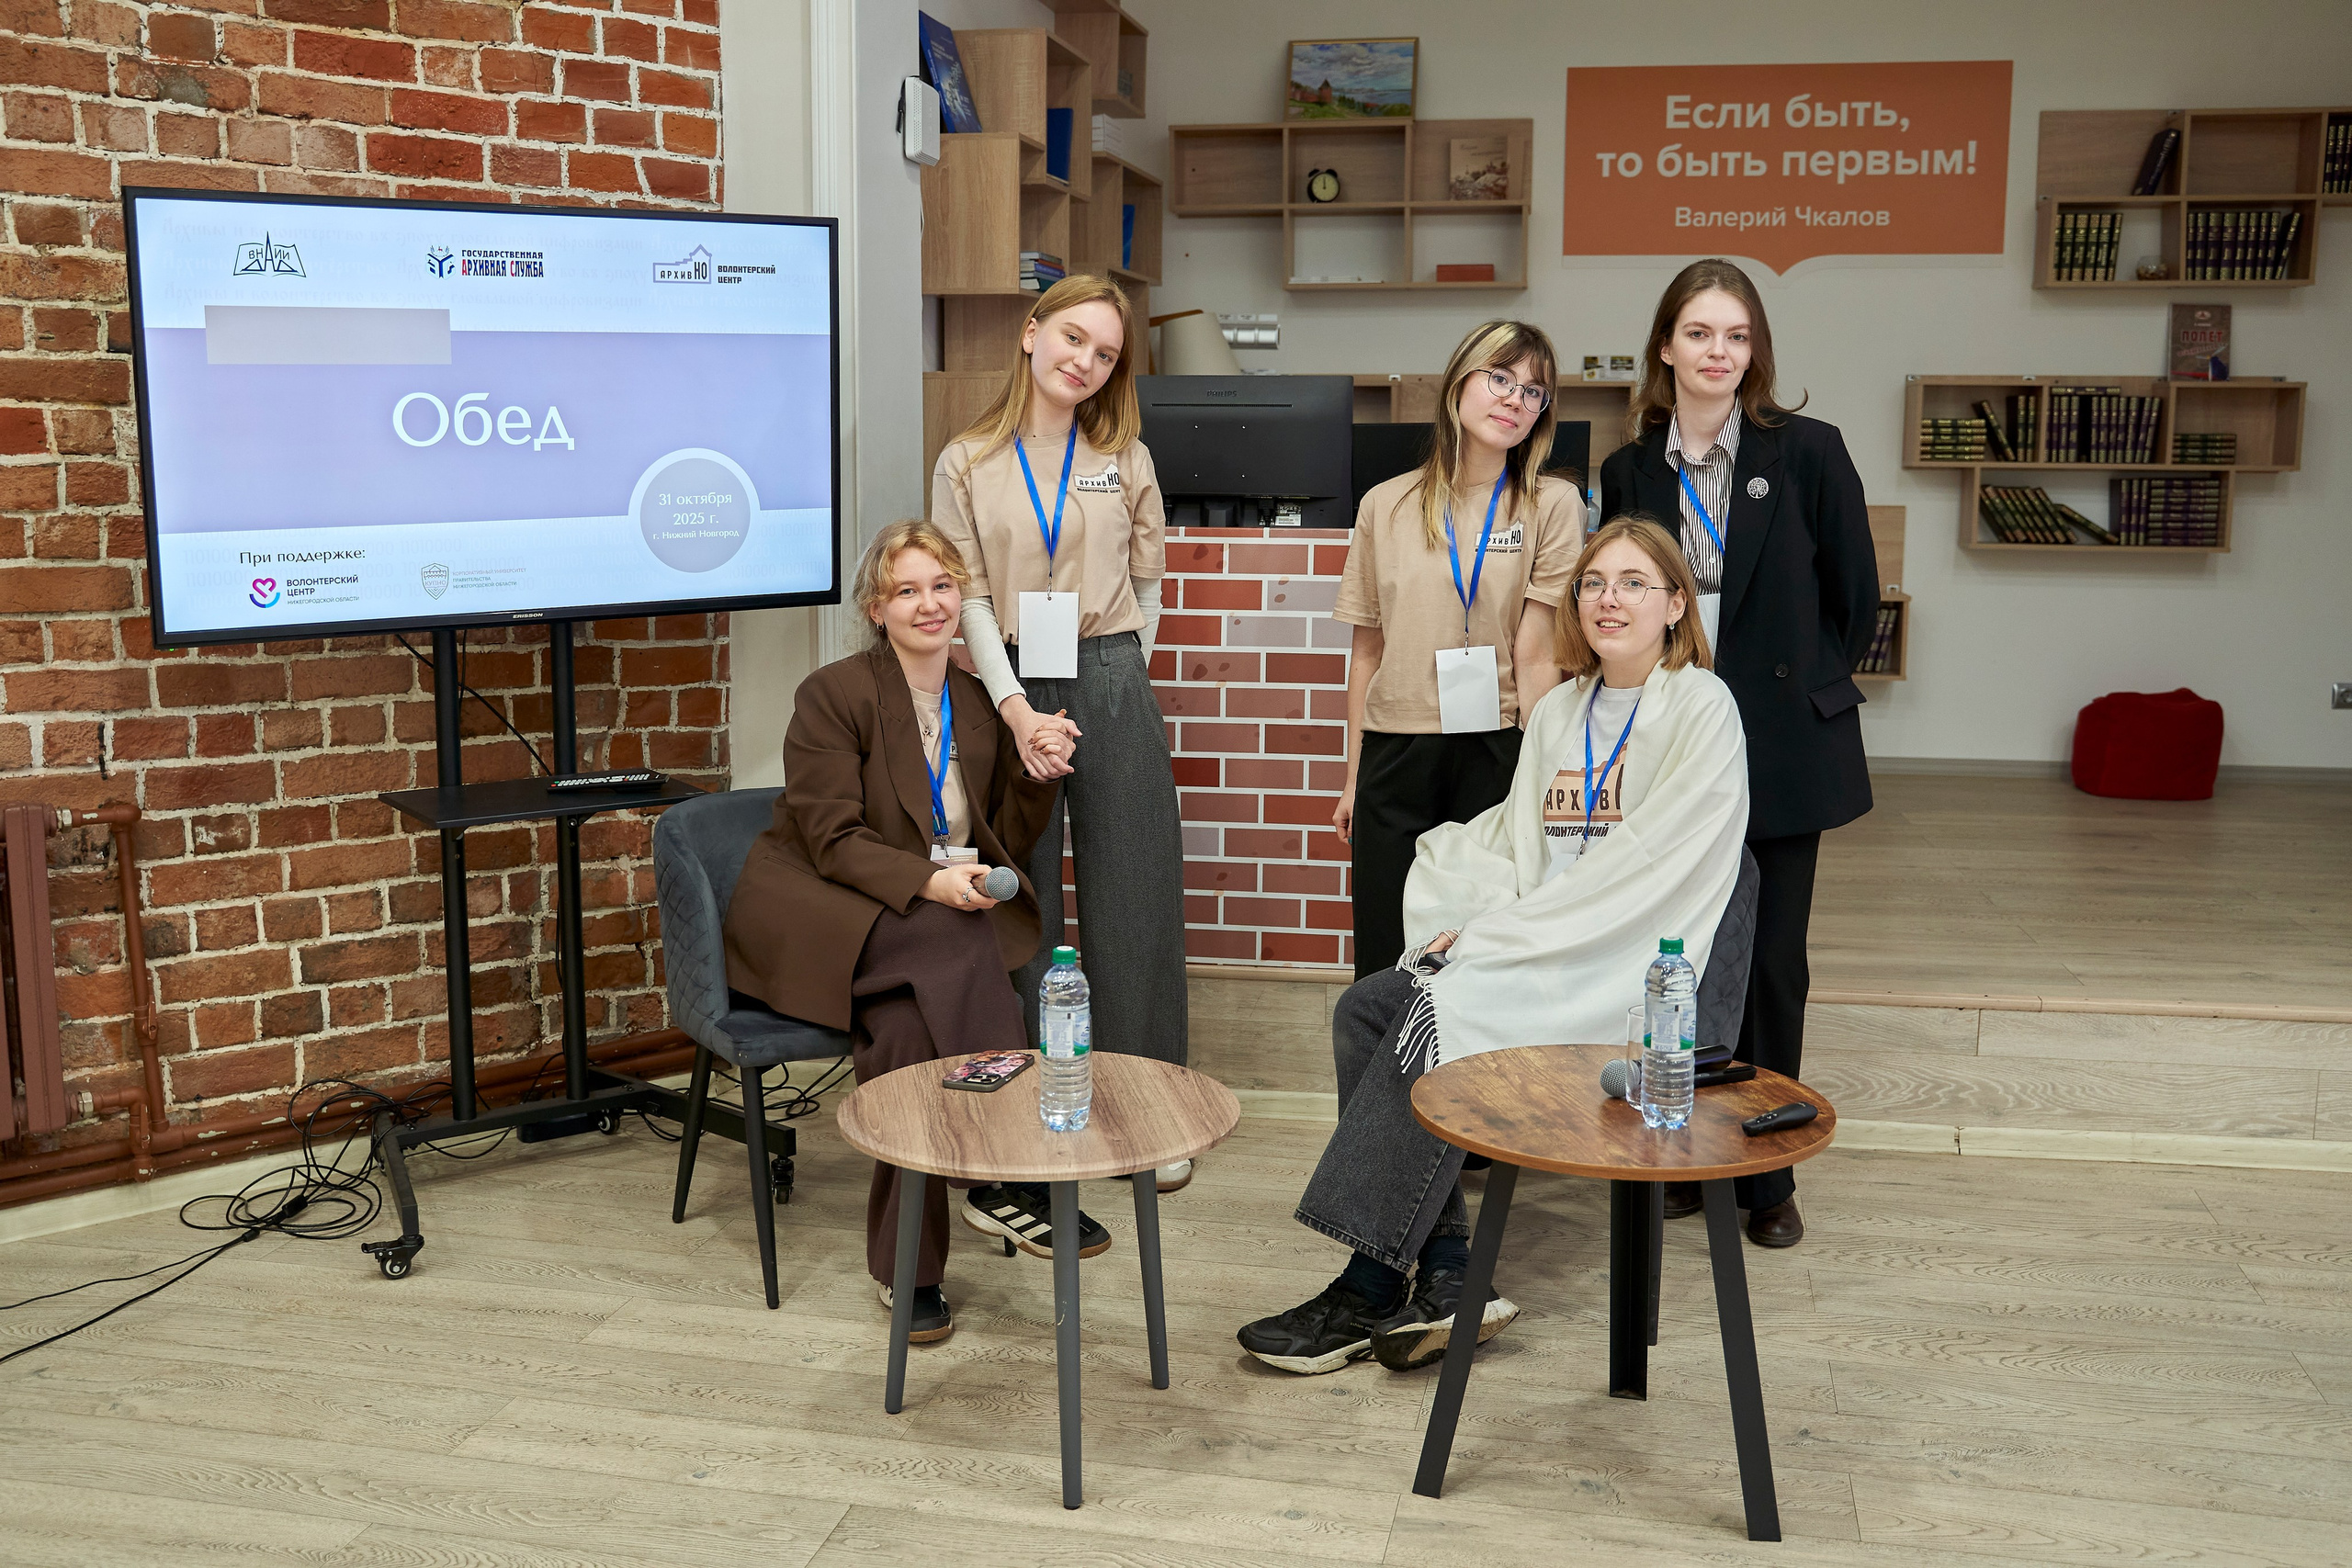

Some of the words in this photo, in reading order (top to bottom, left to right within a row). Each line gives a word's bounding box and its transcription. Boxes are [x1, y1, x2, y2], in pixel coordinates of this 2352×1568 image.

[1666, 95, 1770, 129] Если
[1785, 94, 1910, 132] быть,
[1596, 152, 1643, 177] то
[1657, 143, 1767, 177] быть
[1782, 141, 1977, 185] первым!
[1675, 207, 1786, 231] Валерий
[1794, 206, 1890, 227] Чкалов
[461, 249, 543, 259] ГОСУДАРСТВЕННАЯ
[461, 259, 506, 276] АРХИВНАЯ
[510, 260, 544, 277] СЛУЖБА
[718, 265, 775, 275] ВОЛОНТЕРСКИЙ
[392, 392, 575, 451] Обед
[659, 493, 672, 506] 31
[676, 492, 732, 507] октября
[673, 513, 705, 525] 2025
[709, 513, 719, 524] г.
[662, 531, 696, 539] Нижний
[699, 529, 740, 538] Новгород
[1487, 529, 1521, 545] РХИВНО
[240, 552, 271, 567] При
[277, 548, 366, 563] поддержке:
[287, 574, 358, 587] ВОЛОНТЕРСКИЙ
[287, 588, 316, 597] ЦЕНТР
